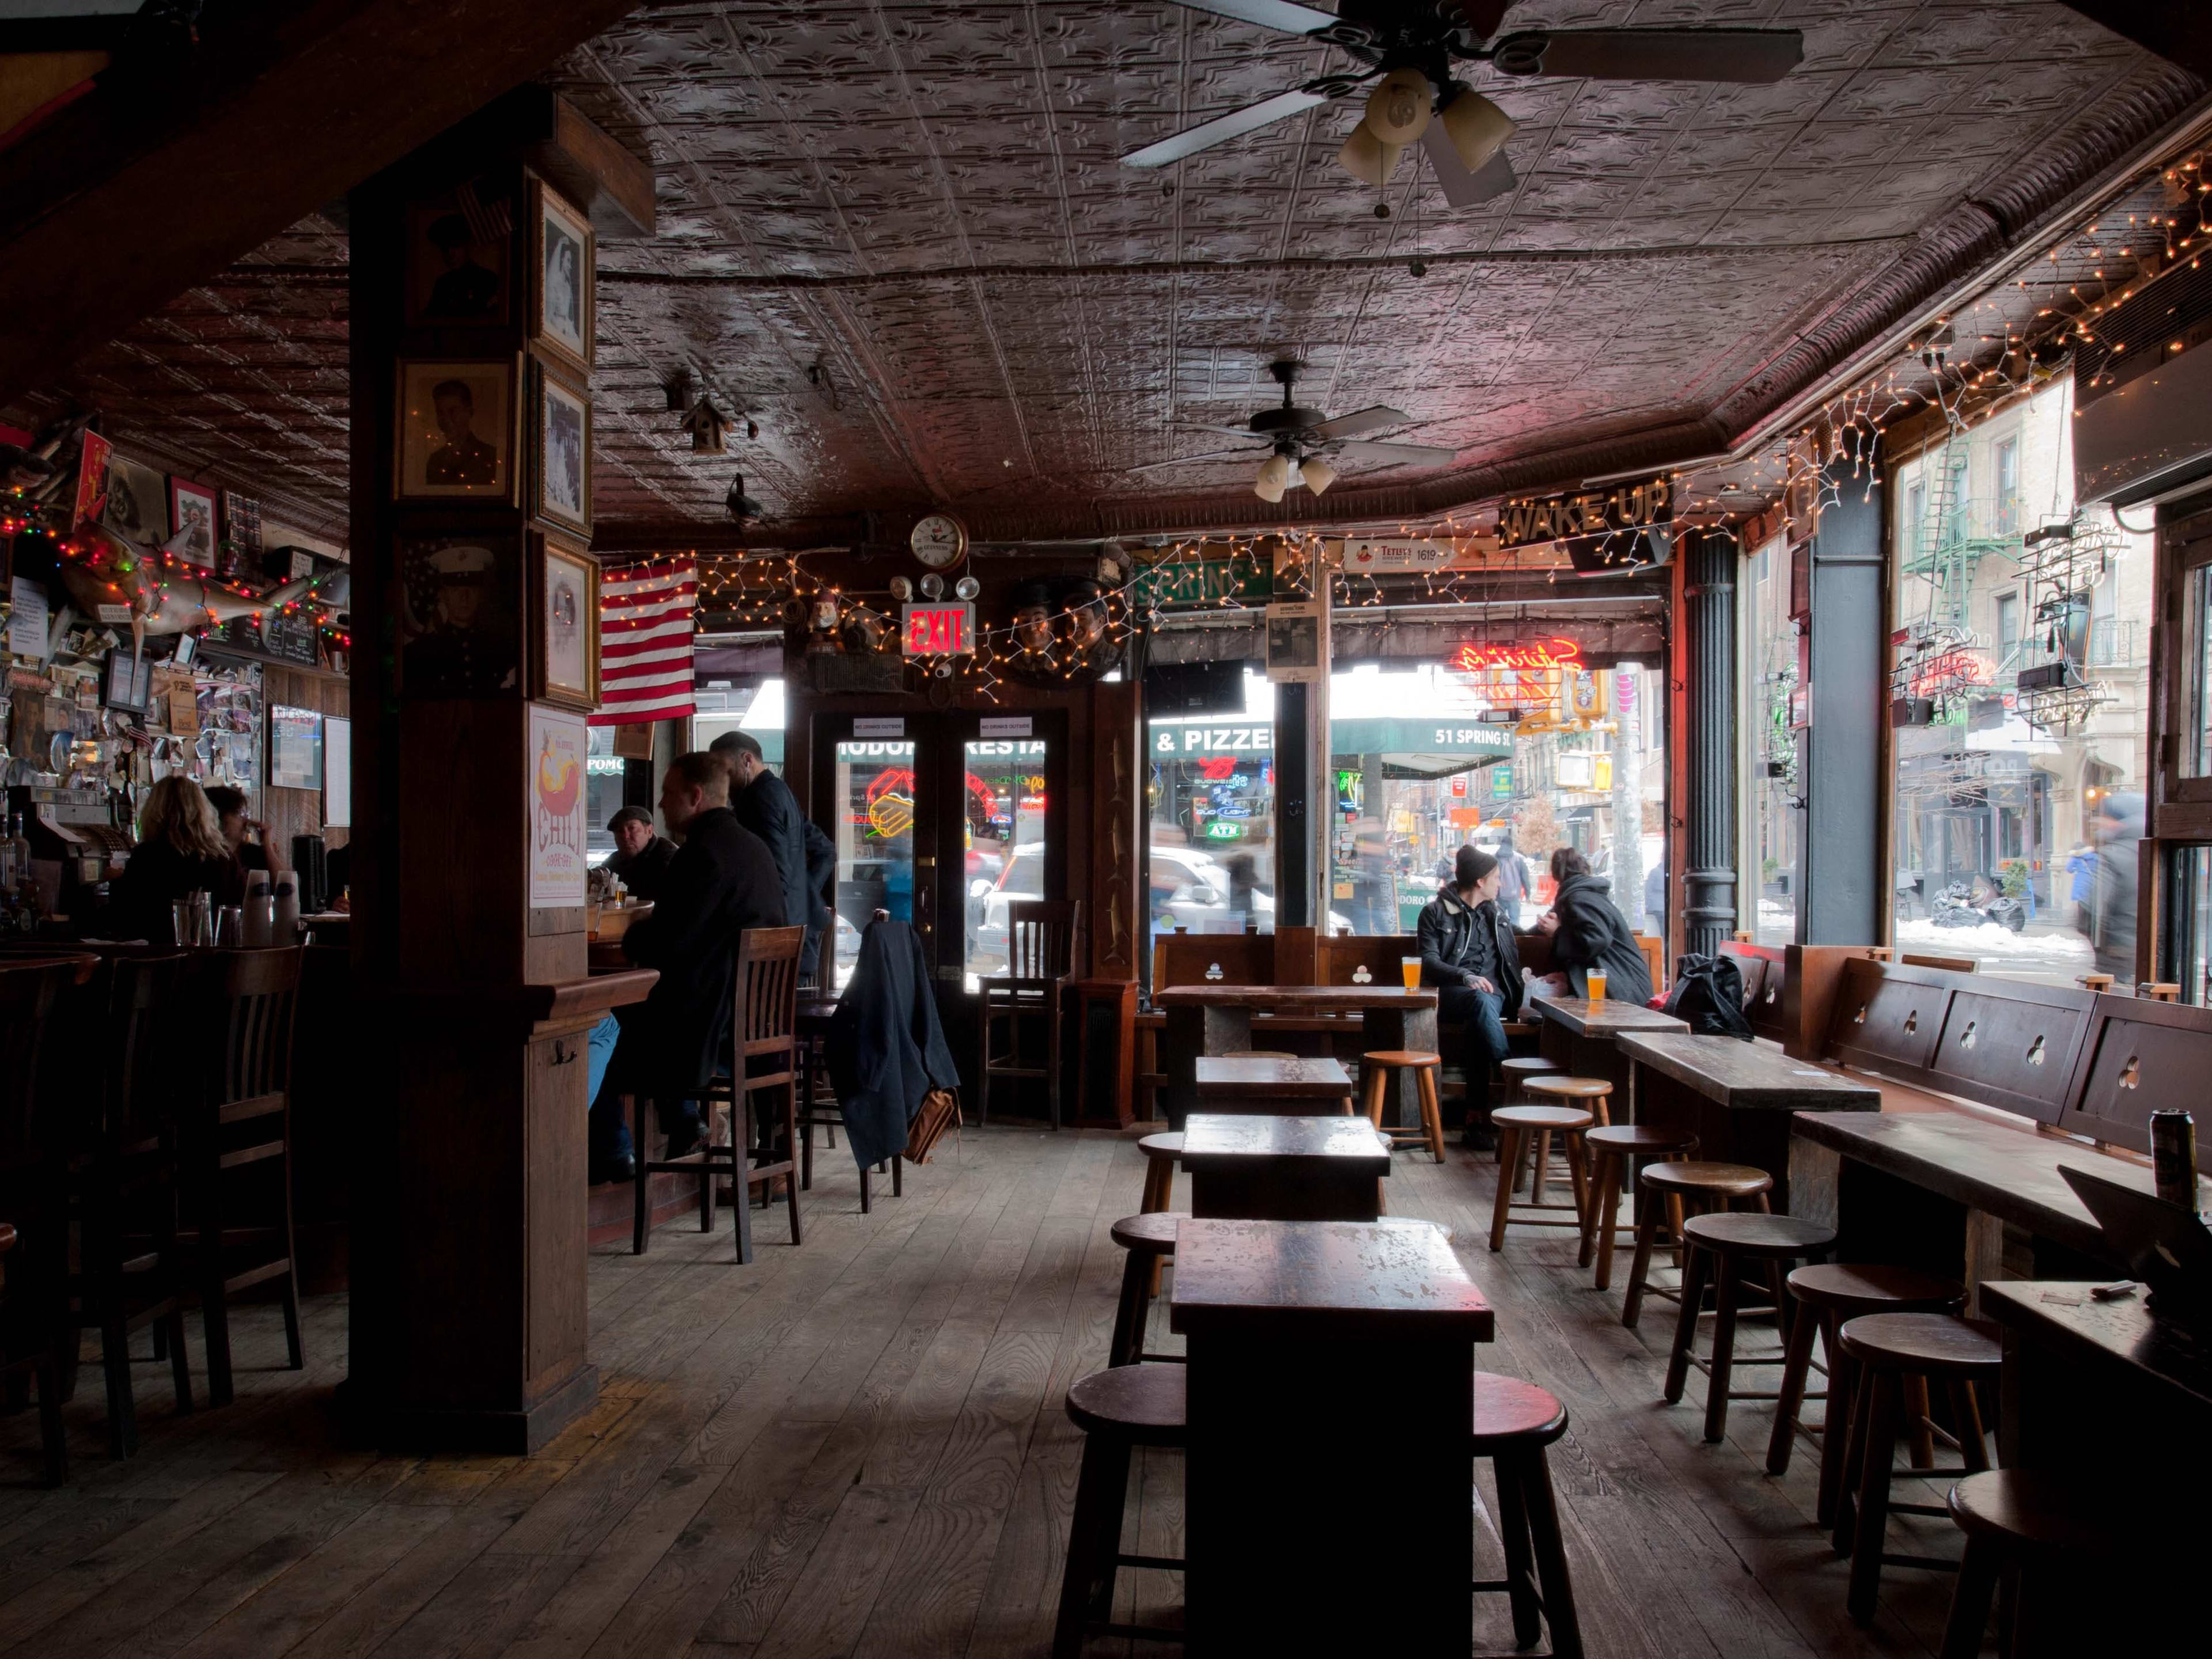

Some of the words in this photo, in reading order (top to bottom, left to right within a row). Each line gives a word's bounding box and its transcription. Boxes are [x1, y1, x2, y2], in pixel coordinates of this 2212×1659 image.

[1501, 493, 1605, 543] WAKE
[1618, 483, 1669, 524] UP
[1417, 549, 1436, 561] 1619
[1138, 563, 1245, 602] SPRING
[1249, 563, 1269, 579] ST
[910, 610, 965, 652] EXIT
[1157, 733, 1176, 752] &
[1185, 728, 1274, 751] PIZZE
[1435, 729, 1453, 744] 51
[1456, 729, 1501, 745] SPRING
[537, 802, 581, 857] CHILI
[1210, 824, 1237, 835] ATM
